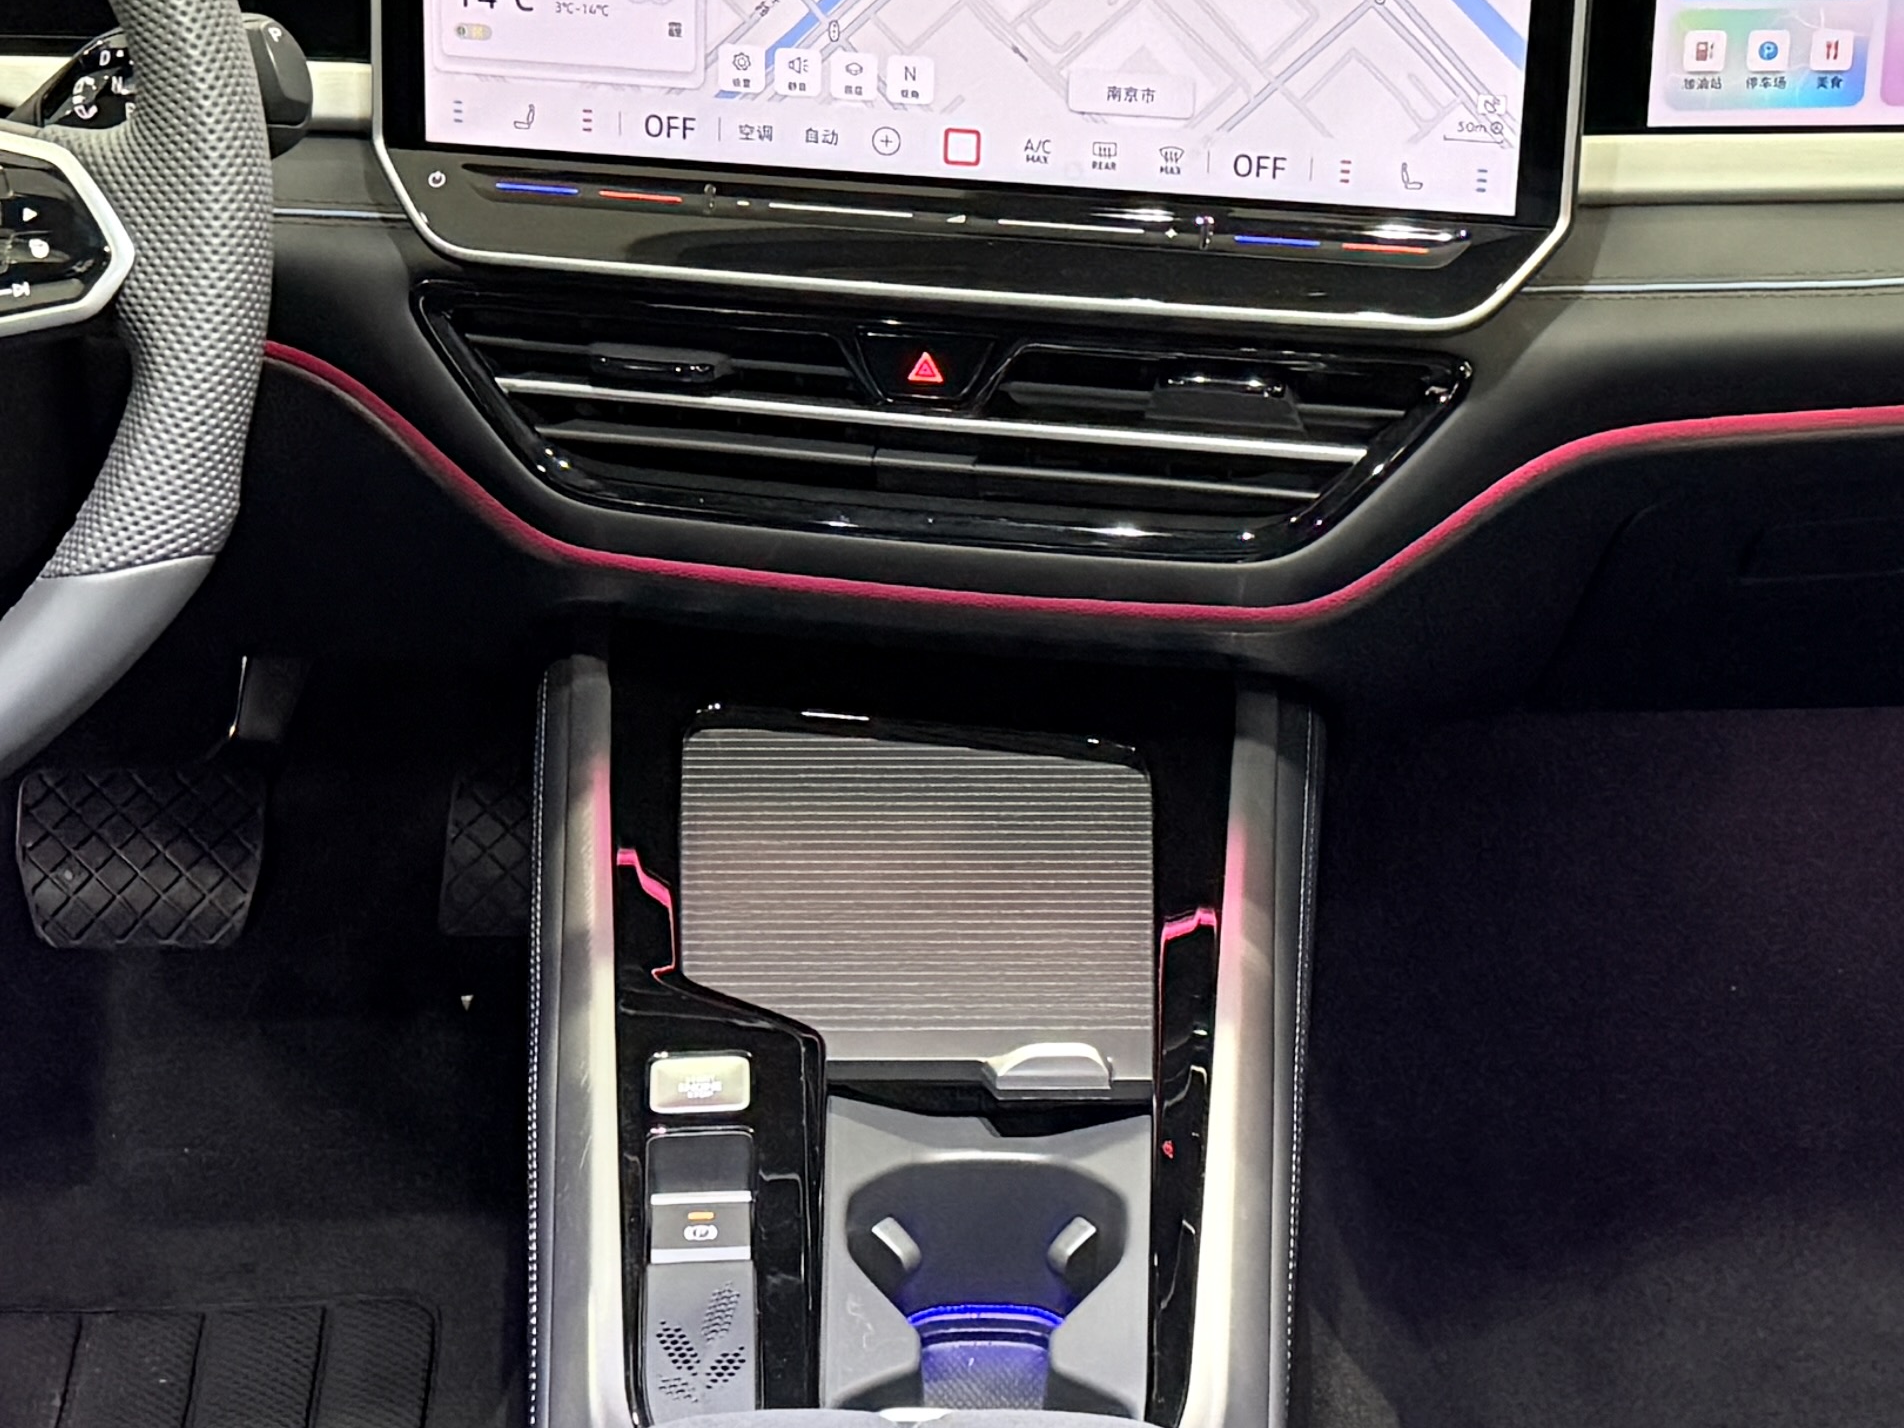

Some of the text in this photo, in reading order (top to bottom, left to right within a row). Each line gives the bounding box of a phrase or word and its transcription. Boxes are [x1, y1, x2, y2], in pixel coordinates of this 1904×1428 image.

[268, 27, 282, 42] P
[99, 50, 111, 66] D
[904, 66, 916, 82] N
[111, 75, 123, 94] N
[1106, 85, 1156, 104] 南京市
[644, 114, 697, 140] OFF
[738, 124, 774, 143] 空调
[805, 129, 839, 146] 自动
[1024, 139, 1052, 154] A/C
[1232, 153, 1287, 180] OFF
